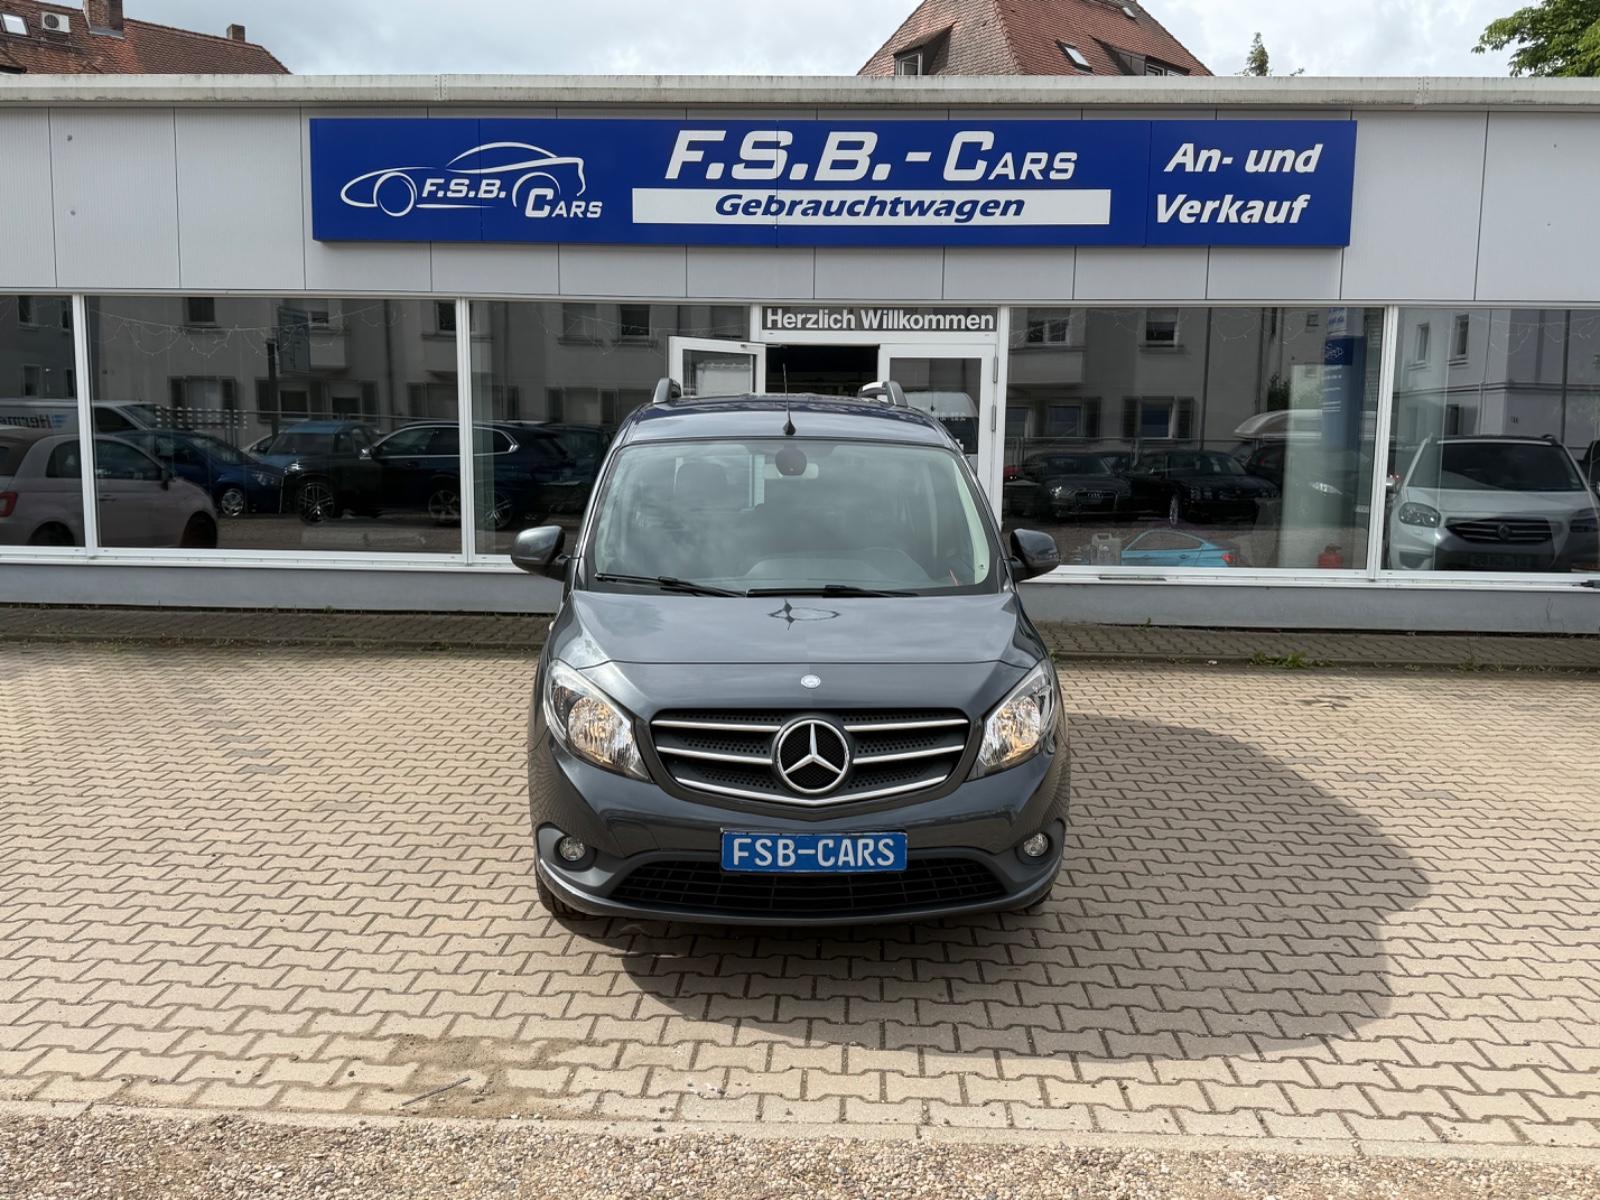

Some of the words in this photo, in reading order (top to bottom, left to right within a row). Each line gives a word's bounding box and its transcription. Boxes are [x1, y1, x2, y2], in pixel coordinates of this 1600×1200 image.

[1163, 143, 1234, 173] An-
[1244, 143, 1324, 173] und
[421, 178, 507, 198] F.S.B.
[524, 187, 603, 218] CARS
[714, 193, 1026, 224] Gebrauchtwagen
[1156, 193, 1312, 224] Verkauf
[766, 307, 856, 329] Herzlich
[860, 308, 995, 330] Willkommen
[732, 837, 896, 868] FSB-CARS
